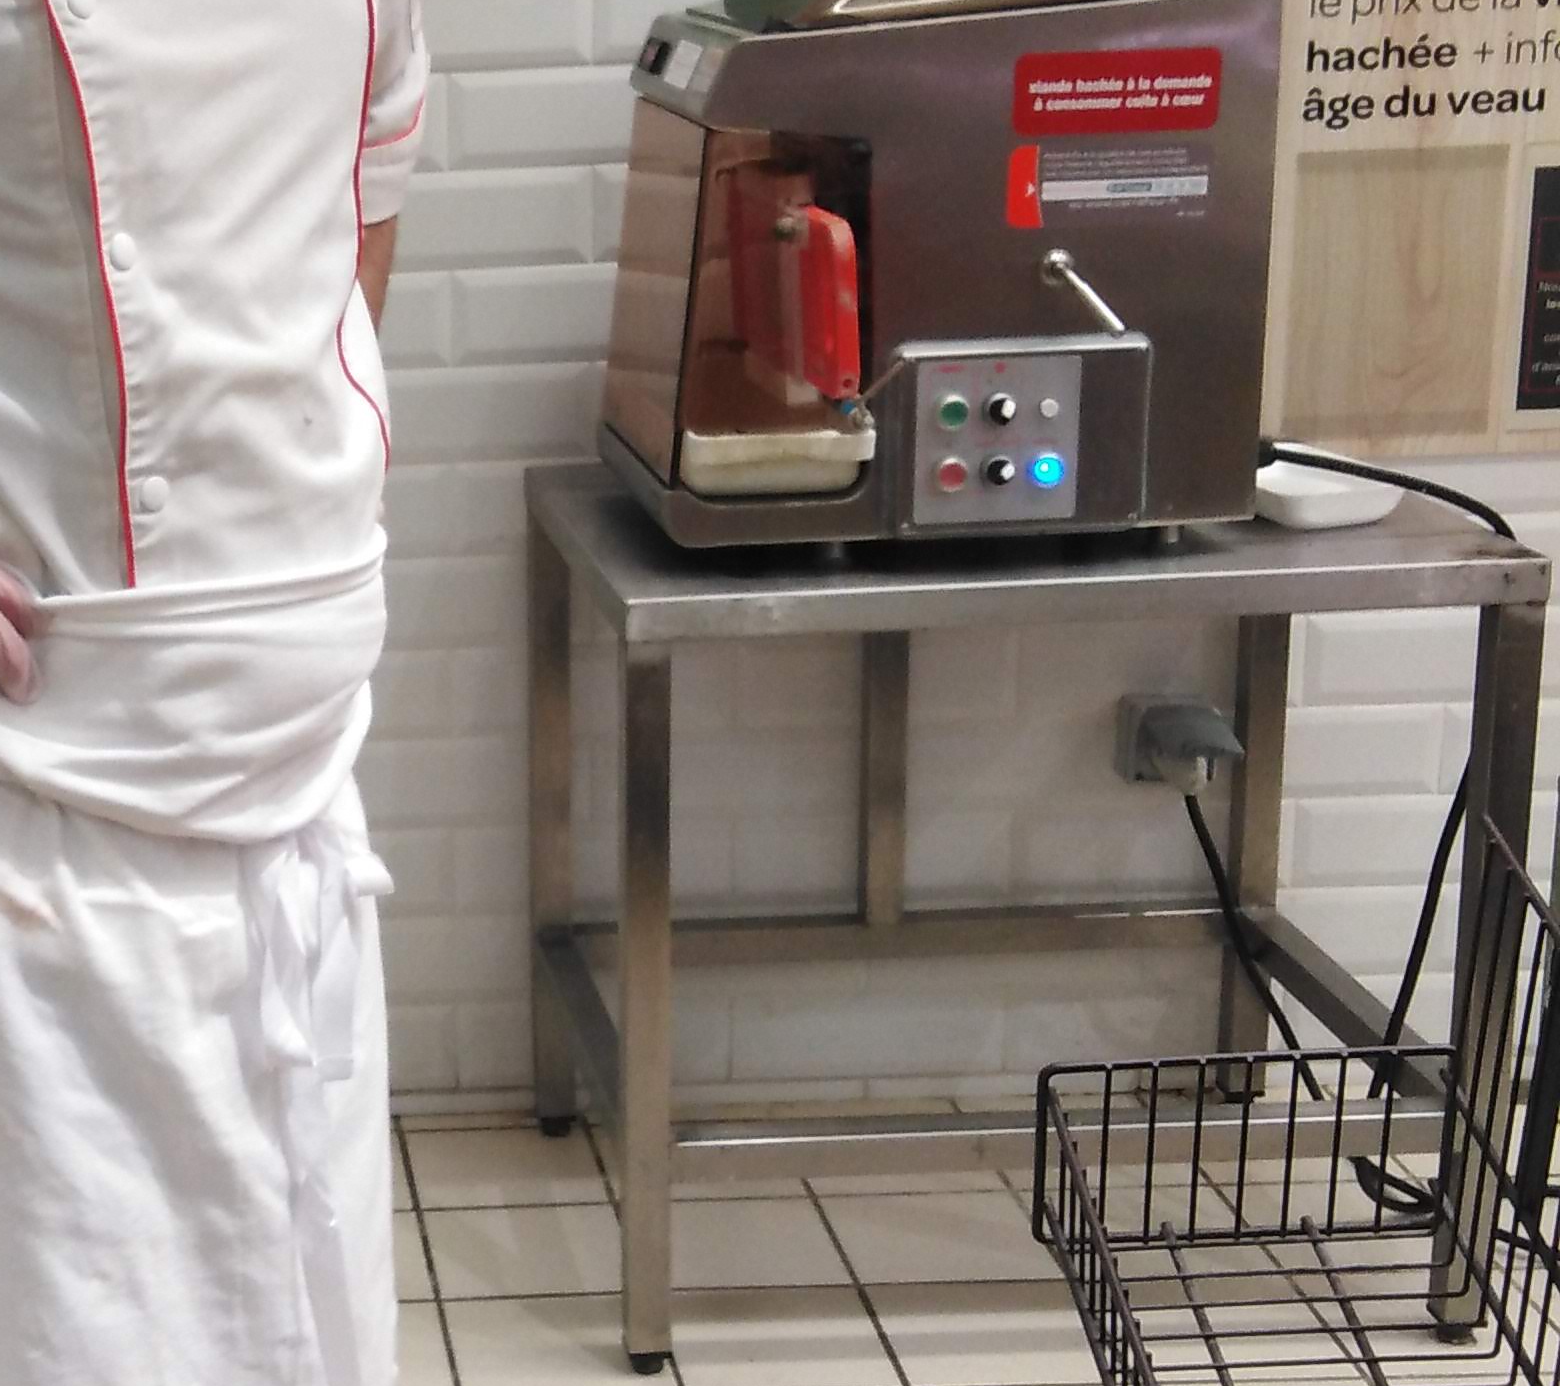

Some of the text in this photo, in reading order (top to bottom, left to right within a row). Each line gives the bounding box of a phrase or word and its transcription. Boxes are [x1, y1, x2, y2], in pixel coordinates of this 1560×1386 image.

[1306, 34, 1457, 72] hachée
[1302, 84, 1546, 130] âge du veau
